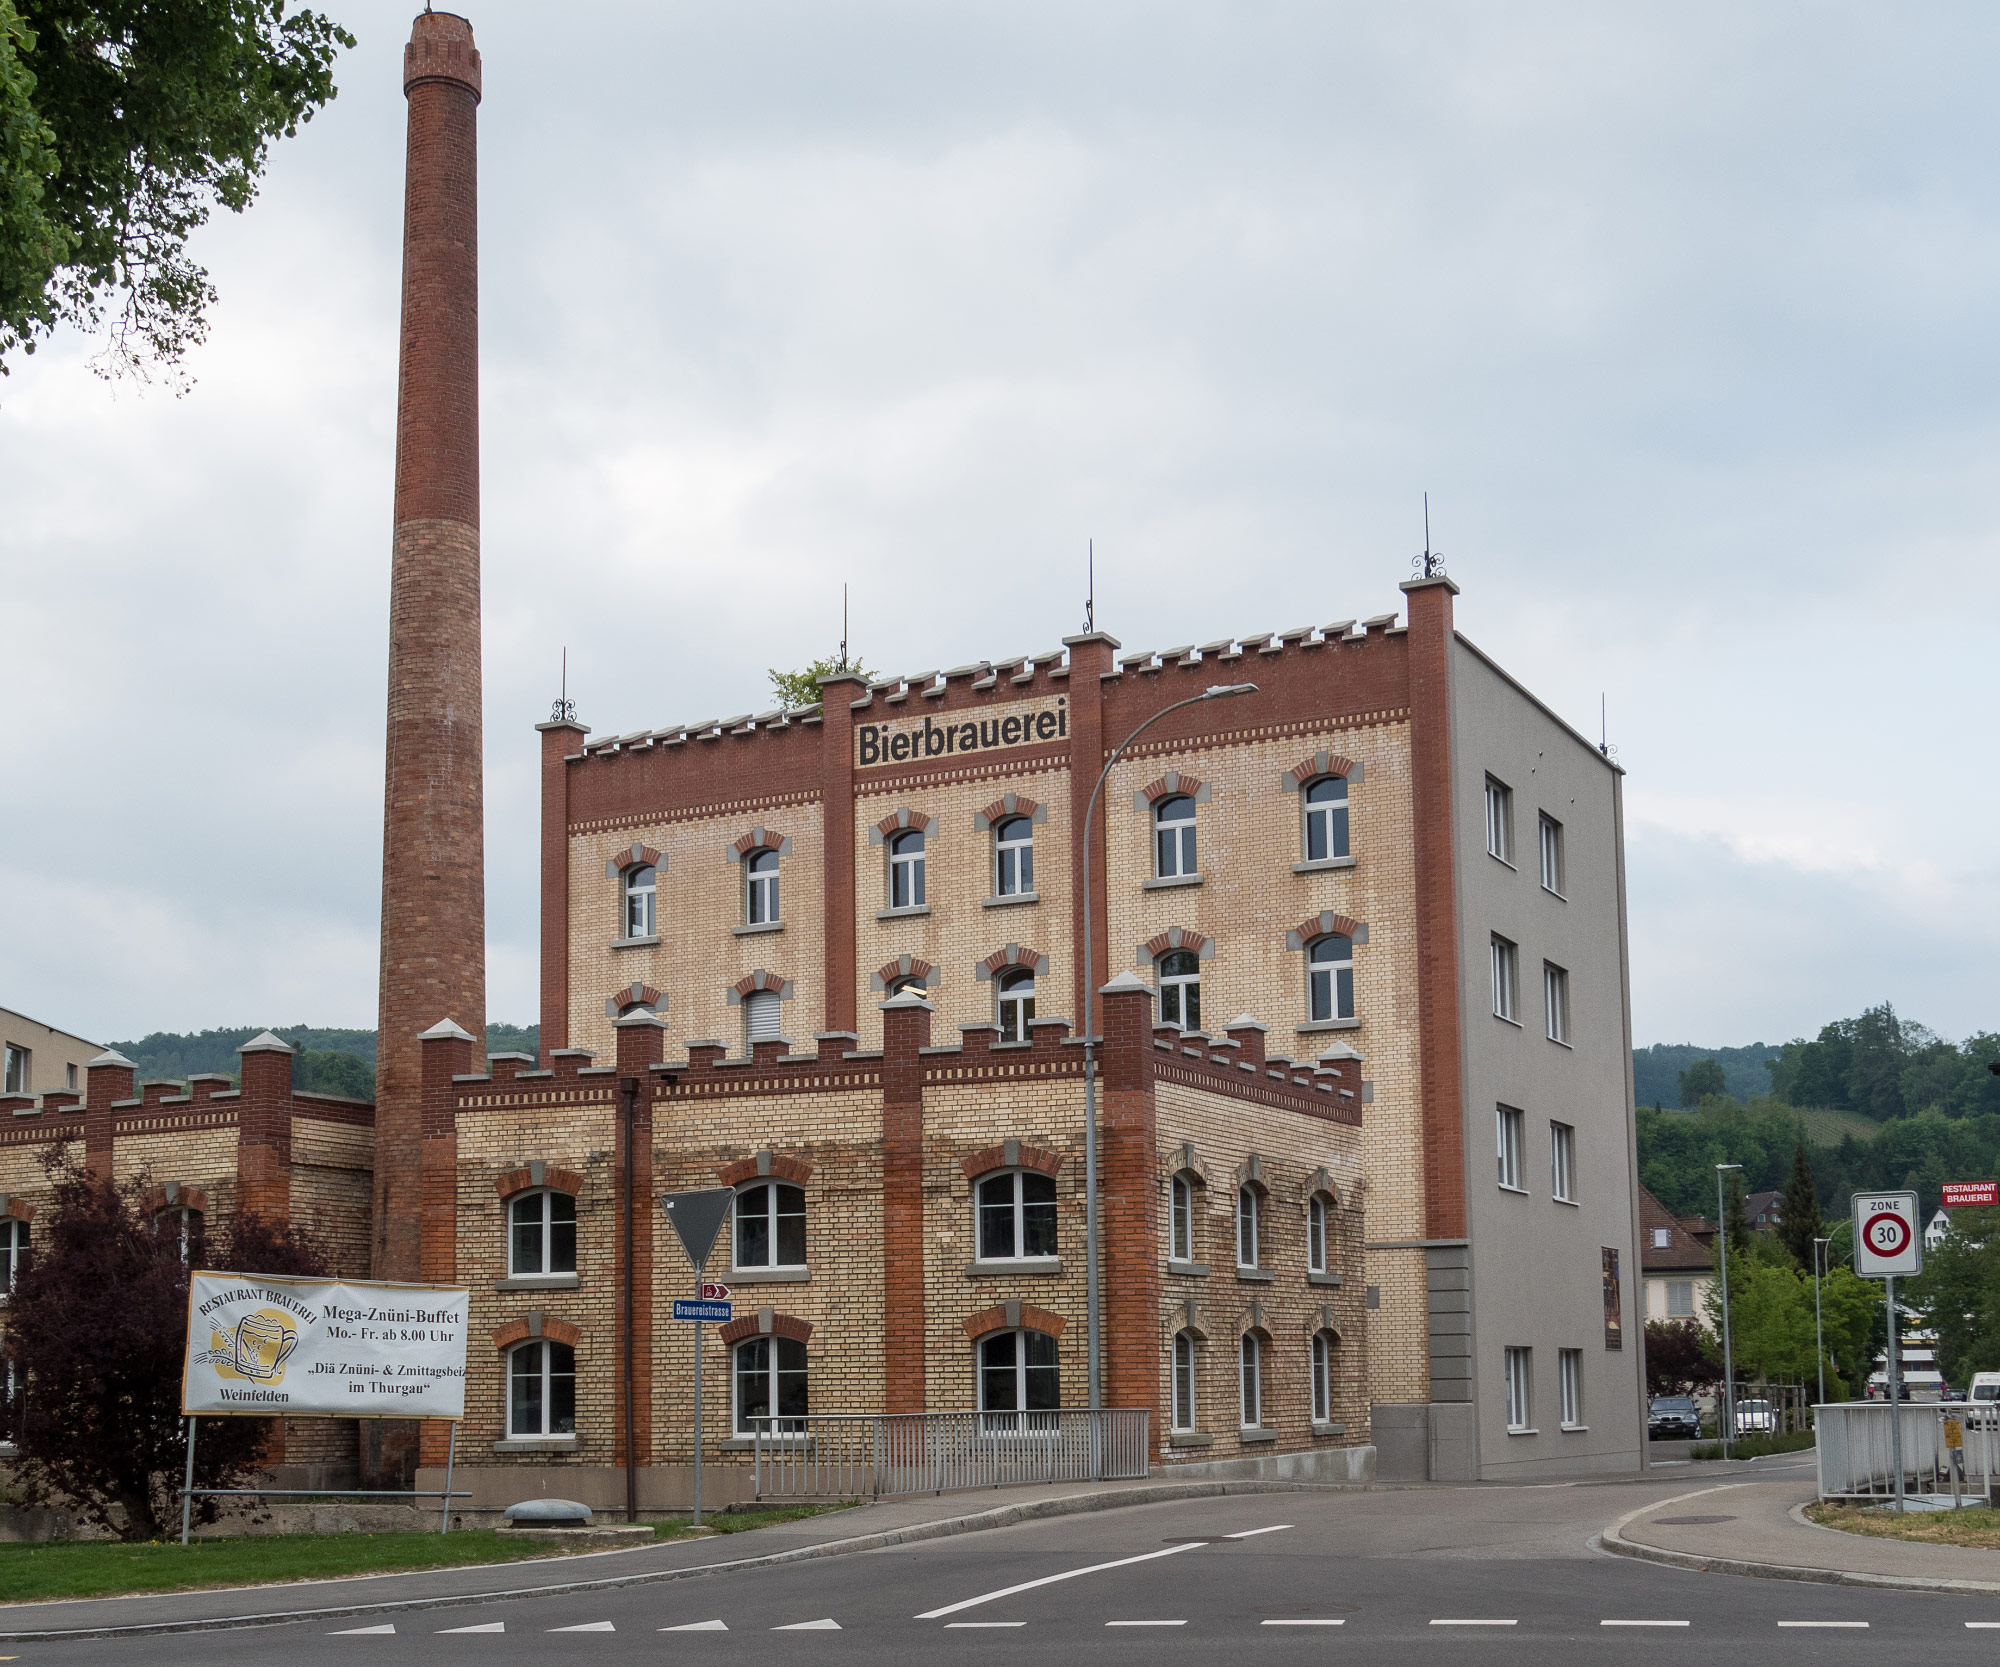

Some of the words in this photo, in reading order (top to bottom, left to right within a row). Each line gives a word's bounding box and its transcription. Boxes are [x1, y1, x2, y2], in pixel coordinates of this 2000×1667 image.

[859, 697, 1066, 766] Bierbrauerei
[1942, 1183, 1997, 1193] RESTAURANT
[1946, 1193, 1992, 1203] BRAUEREI
[1870, 1200, 1900, 1211] ZONE
[1877, 1226, 1897, 1243] 30
[199, 1288, 263, 1316] RESTAURANT
[266, 1290, 318, 1325] BRAUEREI
[676, 1303, 730, 1317] Brauereistrasse
[322, 1304, 460, 1324] Mega-Znüni-Buffet
[361, 1327, 379, 1340] Fr.
[382, 1328, 397, 1341] ab
[400, 1329, 426, 1342] 8.00
[430, 1329, 455, 1342] Uhr
[339, 1363, 380, 1376] Znüni-
[382, 1364, 394, 1376] &
[348, 1380, 365, 1393] im
[220, 1388, 290, 1402] Weinfelden
